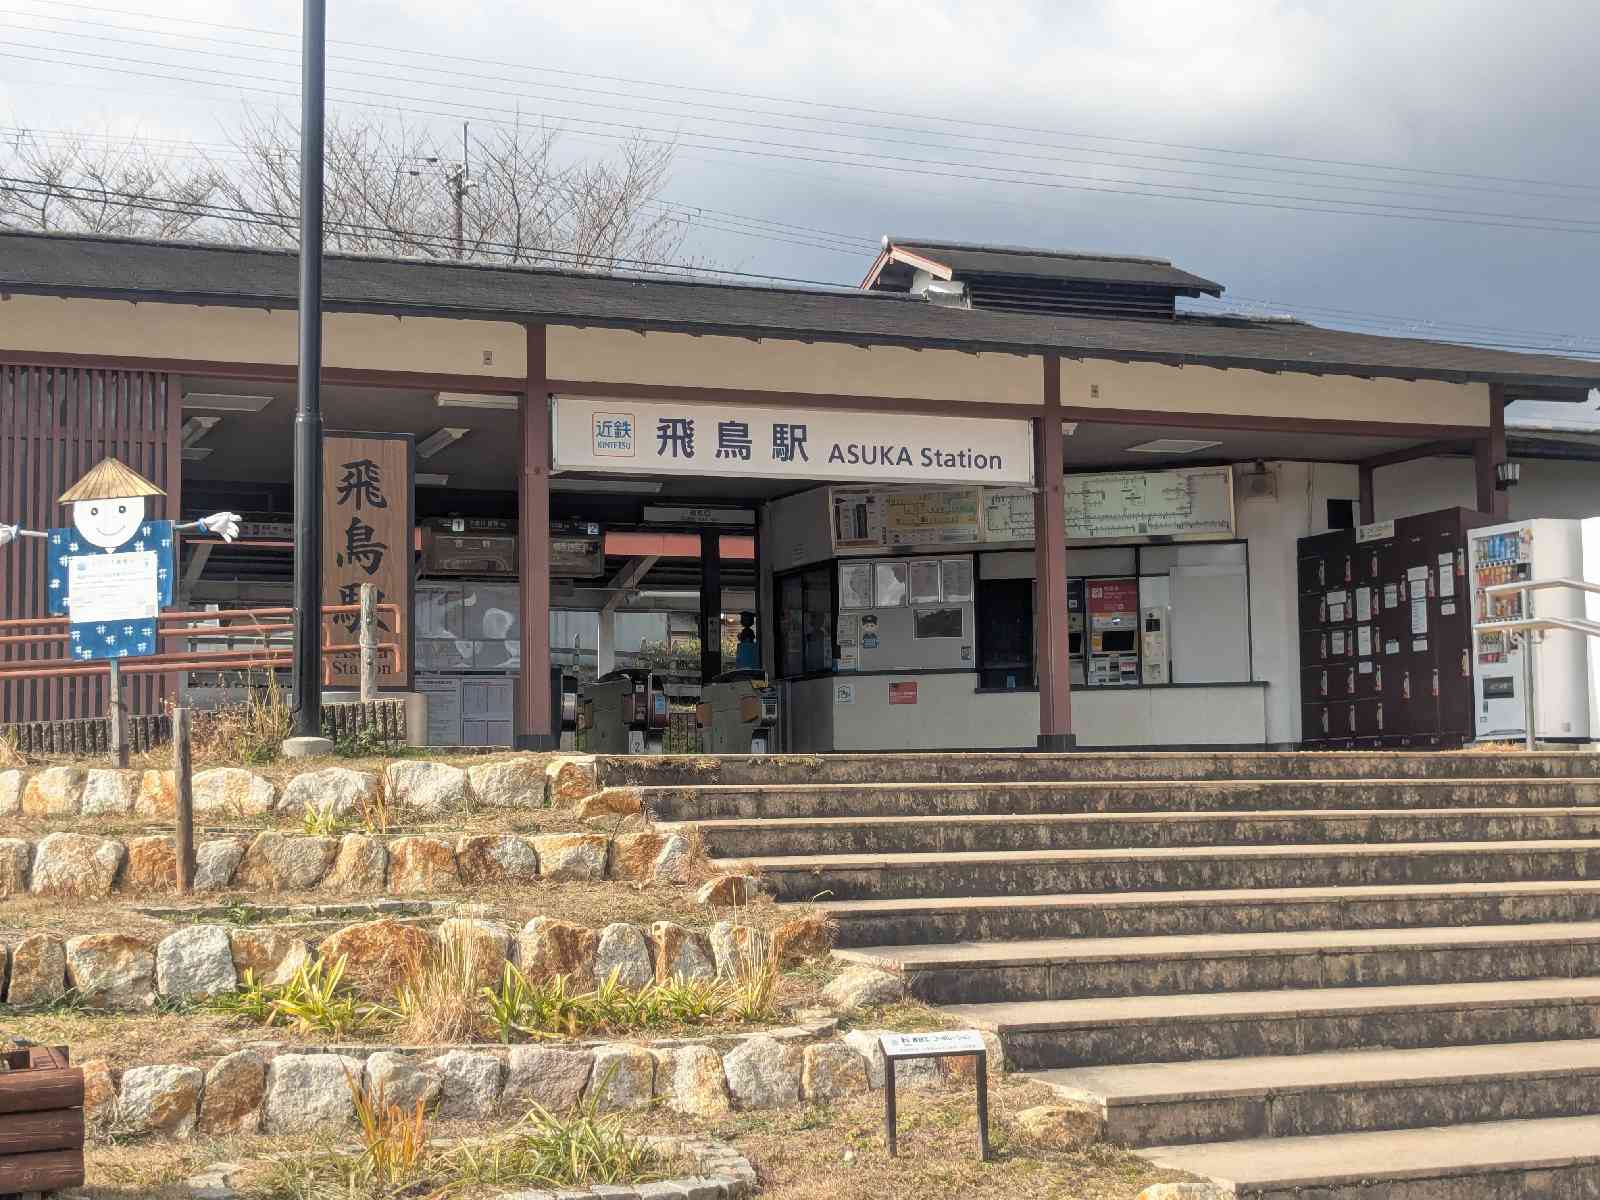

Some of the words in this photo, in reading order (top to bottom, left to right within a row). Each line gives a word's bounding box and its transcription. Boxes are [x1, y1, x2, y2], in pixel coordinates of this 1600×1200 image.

[596, 420, 632, 438] 近鉄
[656, 417, 809, 463] 飛鳥駅
[828, 443, 913, 466] ASUKA
[920, 447, 1003, 470] Station
